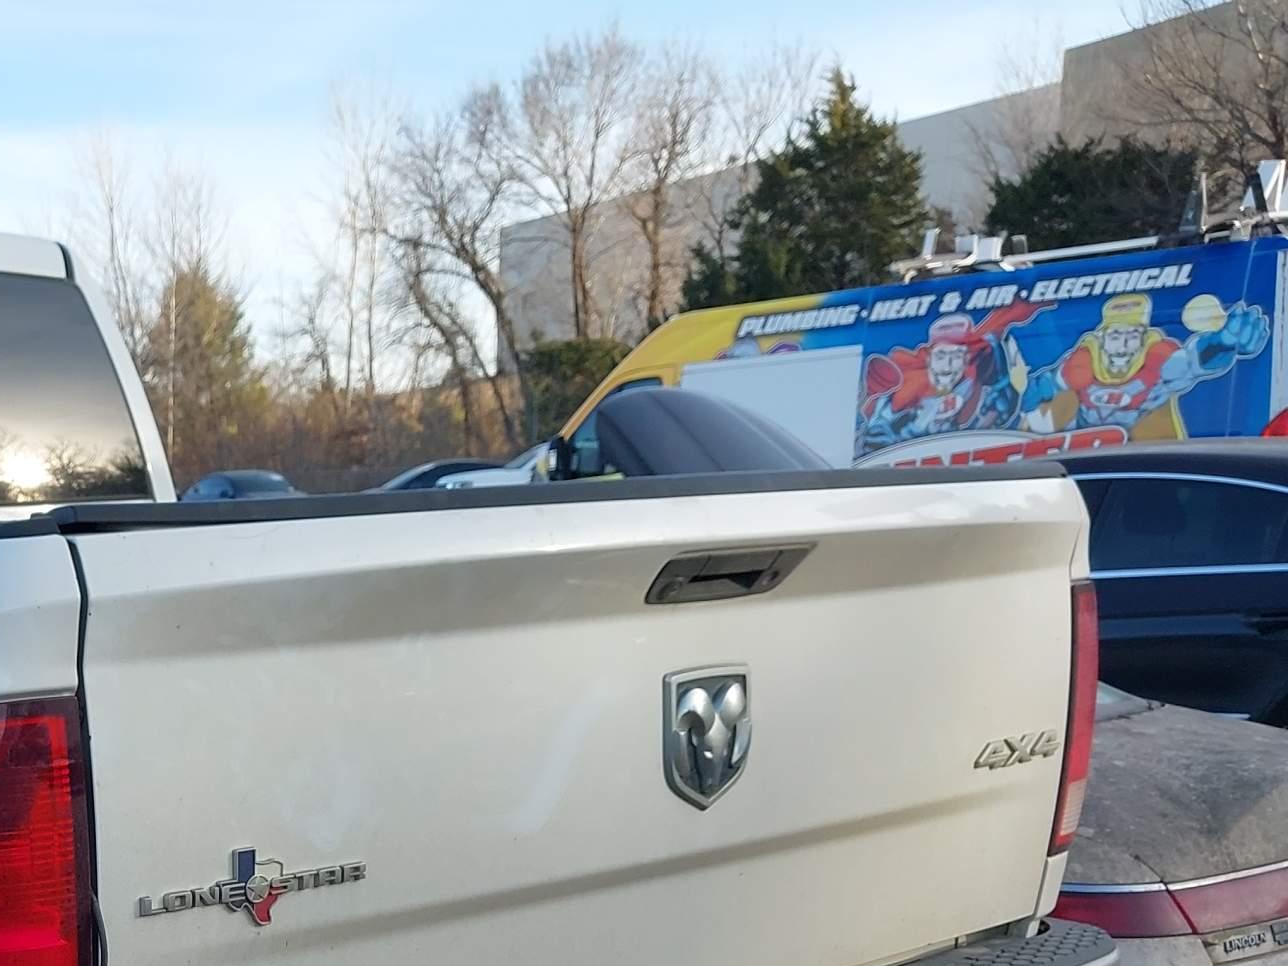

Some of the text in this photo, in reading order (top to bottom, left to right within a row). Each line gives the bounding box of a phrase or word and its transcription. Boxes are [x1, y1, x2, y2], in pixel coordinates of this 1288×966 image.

[738, 263, 1193, 337] PLUMBING HEAT & AIR ELECTRICAL
[137, 860, 367, 917] LONE STAR
